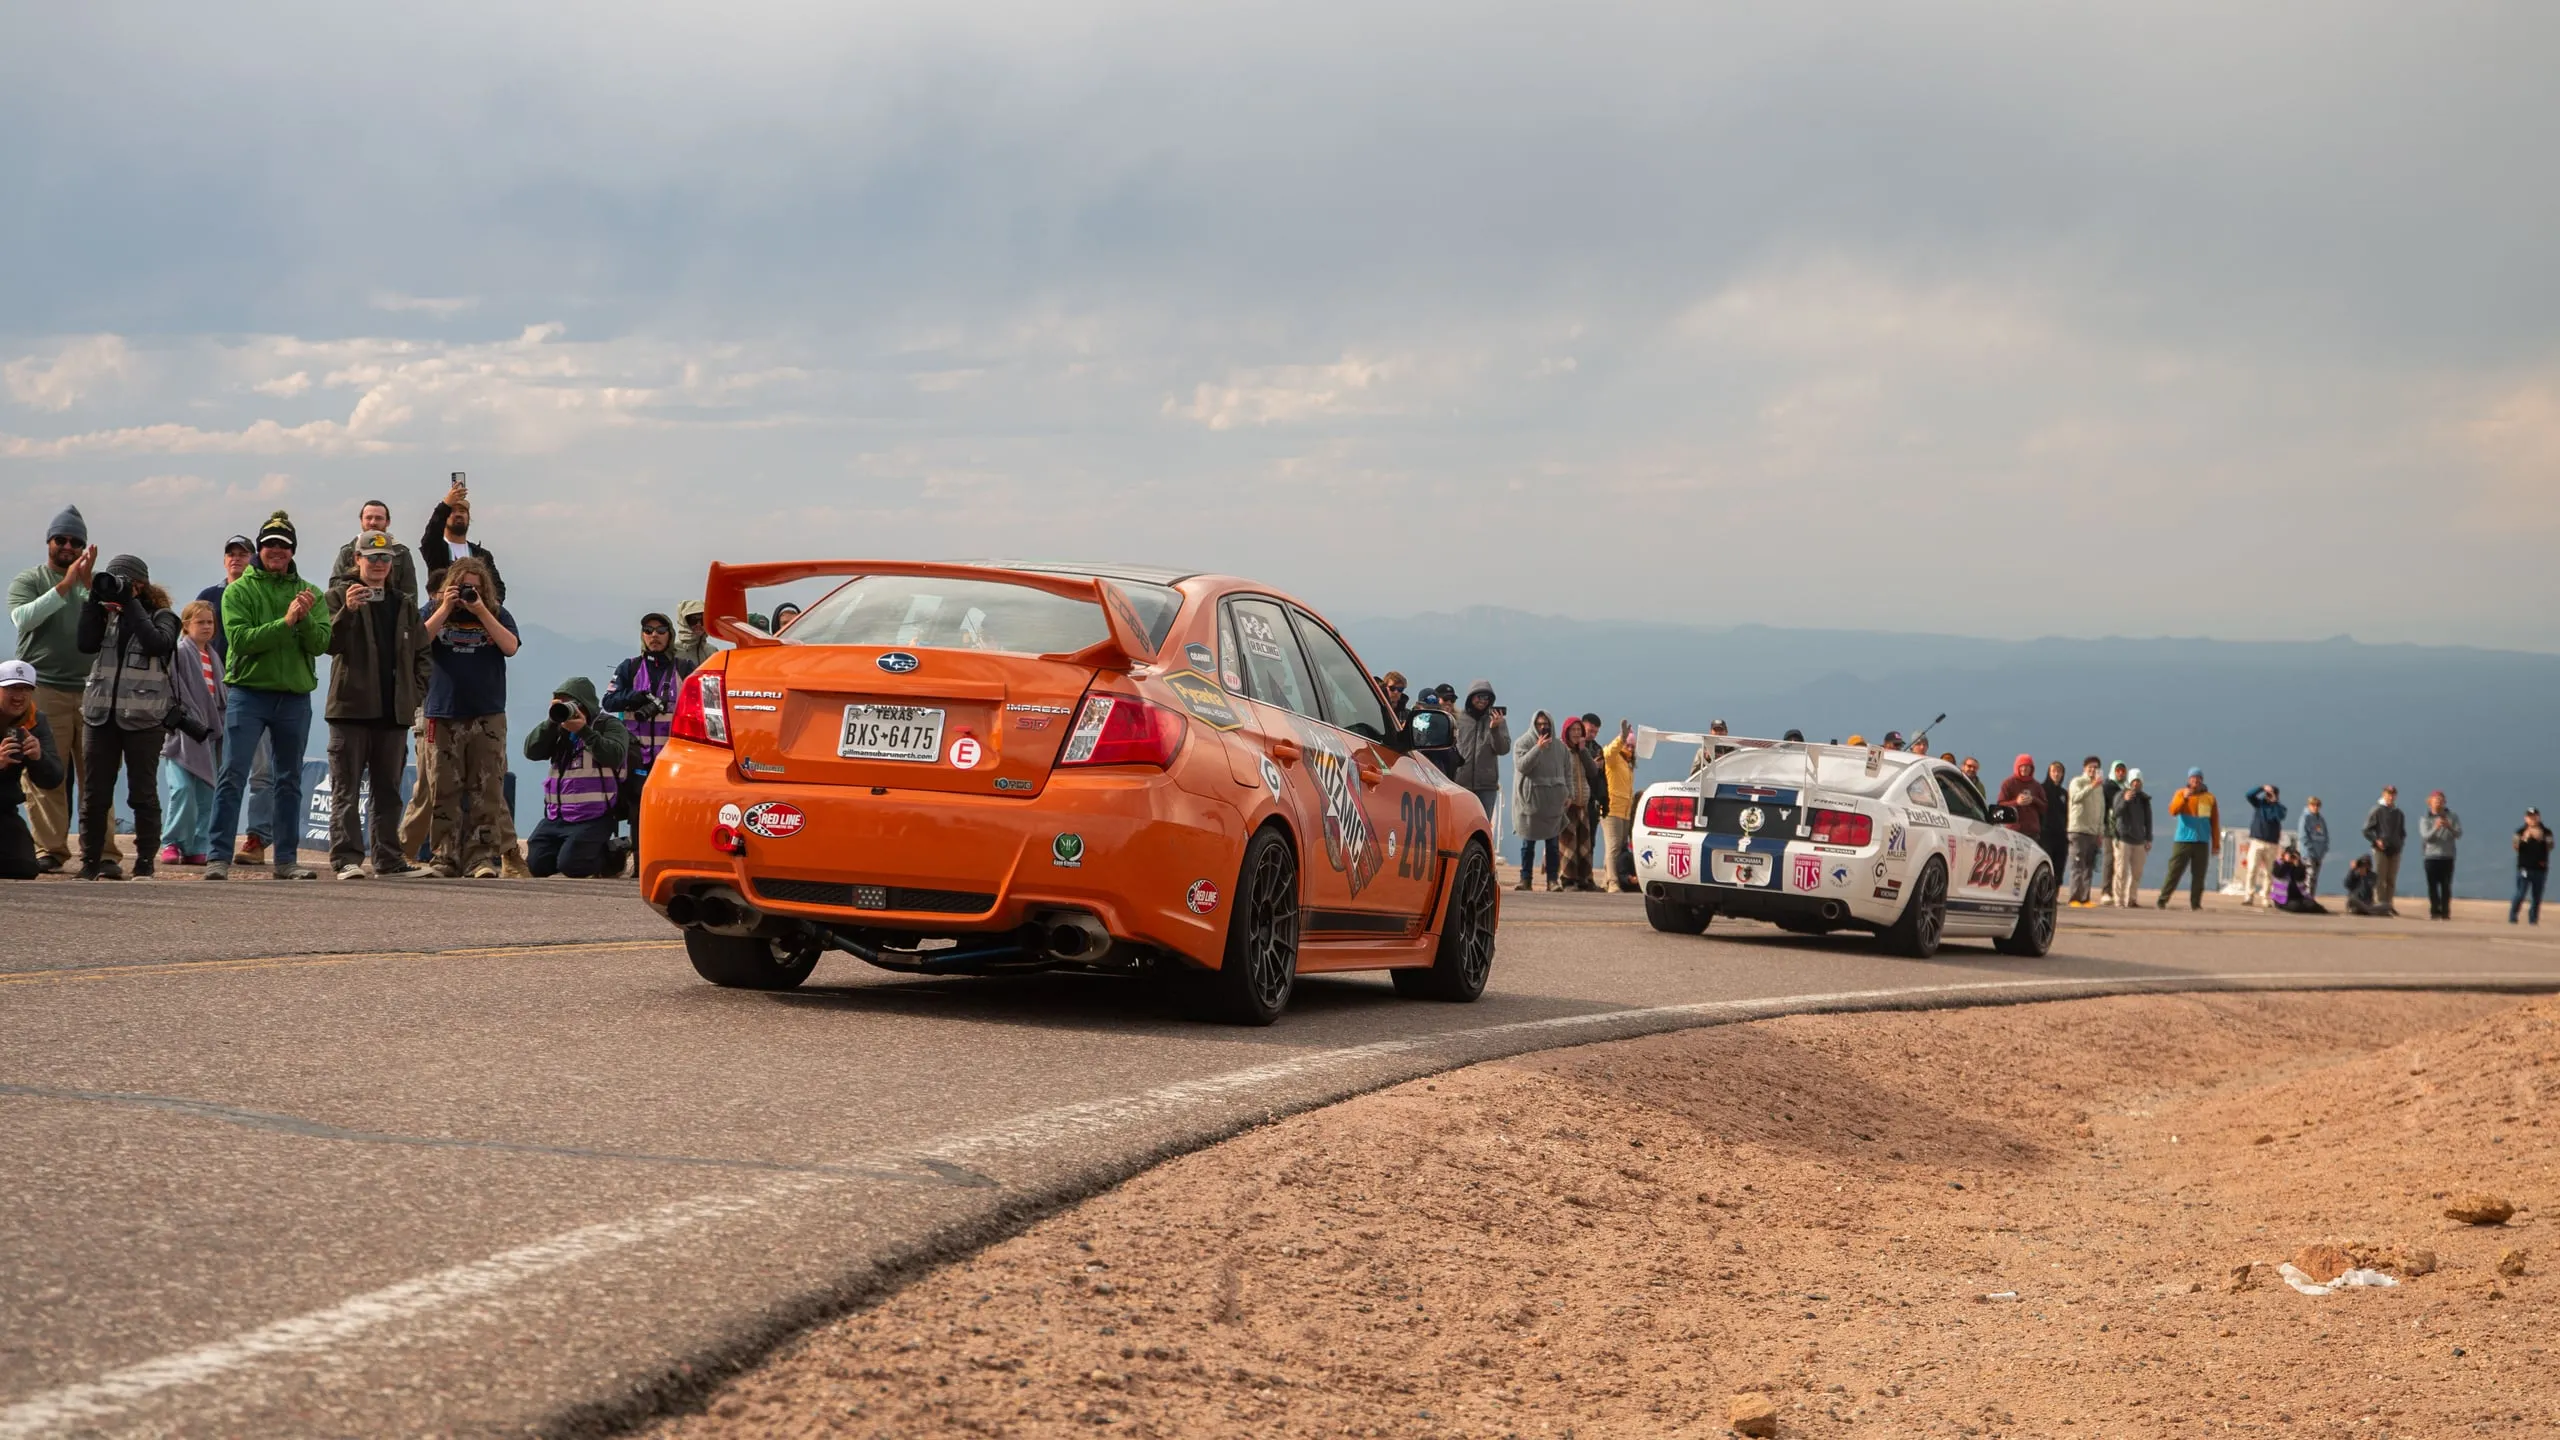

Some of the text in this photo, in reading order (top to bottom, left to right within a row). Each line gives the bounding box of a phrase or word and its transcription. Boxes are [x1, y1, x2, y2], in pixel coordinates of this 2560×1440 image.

[1250, 640, 1280, 657] RACING
[727, 690, 783, 699] SUBARU
[1173, 681, 1226, 707] Pyranha
[875, 710, 913, 721] TEXAS
[1006, 703, 1071, 714] IMPREZA
[845, 722, 935, 750] BXS 6475
[842, 749, 933, 760] gillmansubarunorth.com
[957, 743, 974, 763] E
[1264, 760, 1279, 790] G
[720, 812, 739, 821] TOW
[760, 813, 802, 826] RED LINE
[1902, 808, 1951, 829] FuelTech
[1398, 791, 1437, 882] 281
[1734, 857, 1762, 865] YOKOHAMA
[1887, 850, 1907, 858] MILLER
[1669, 854, 1690, 878] ALS
[1875, 862, 1885, 878] G
[1795, 865, 1819, 890] ALS
[1196, 890, 1217, 902] RED LINE
